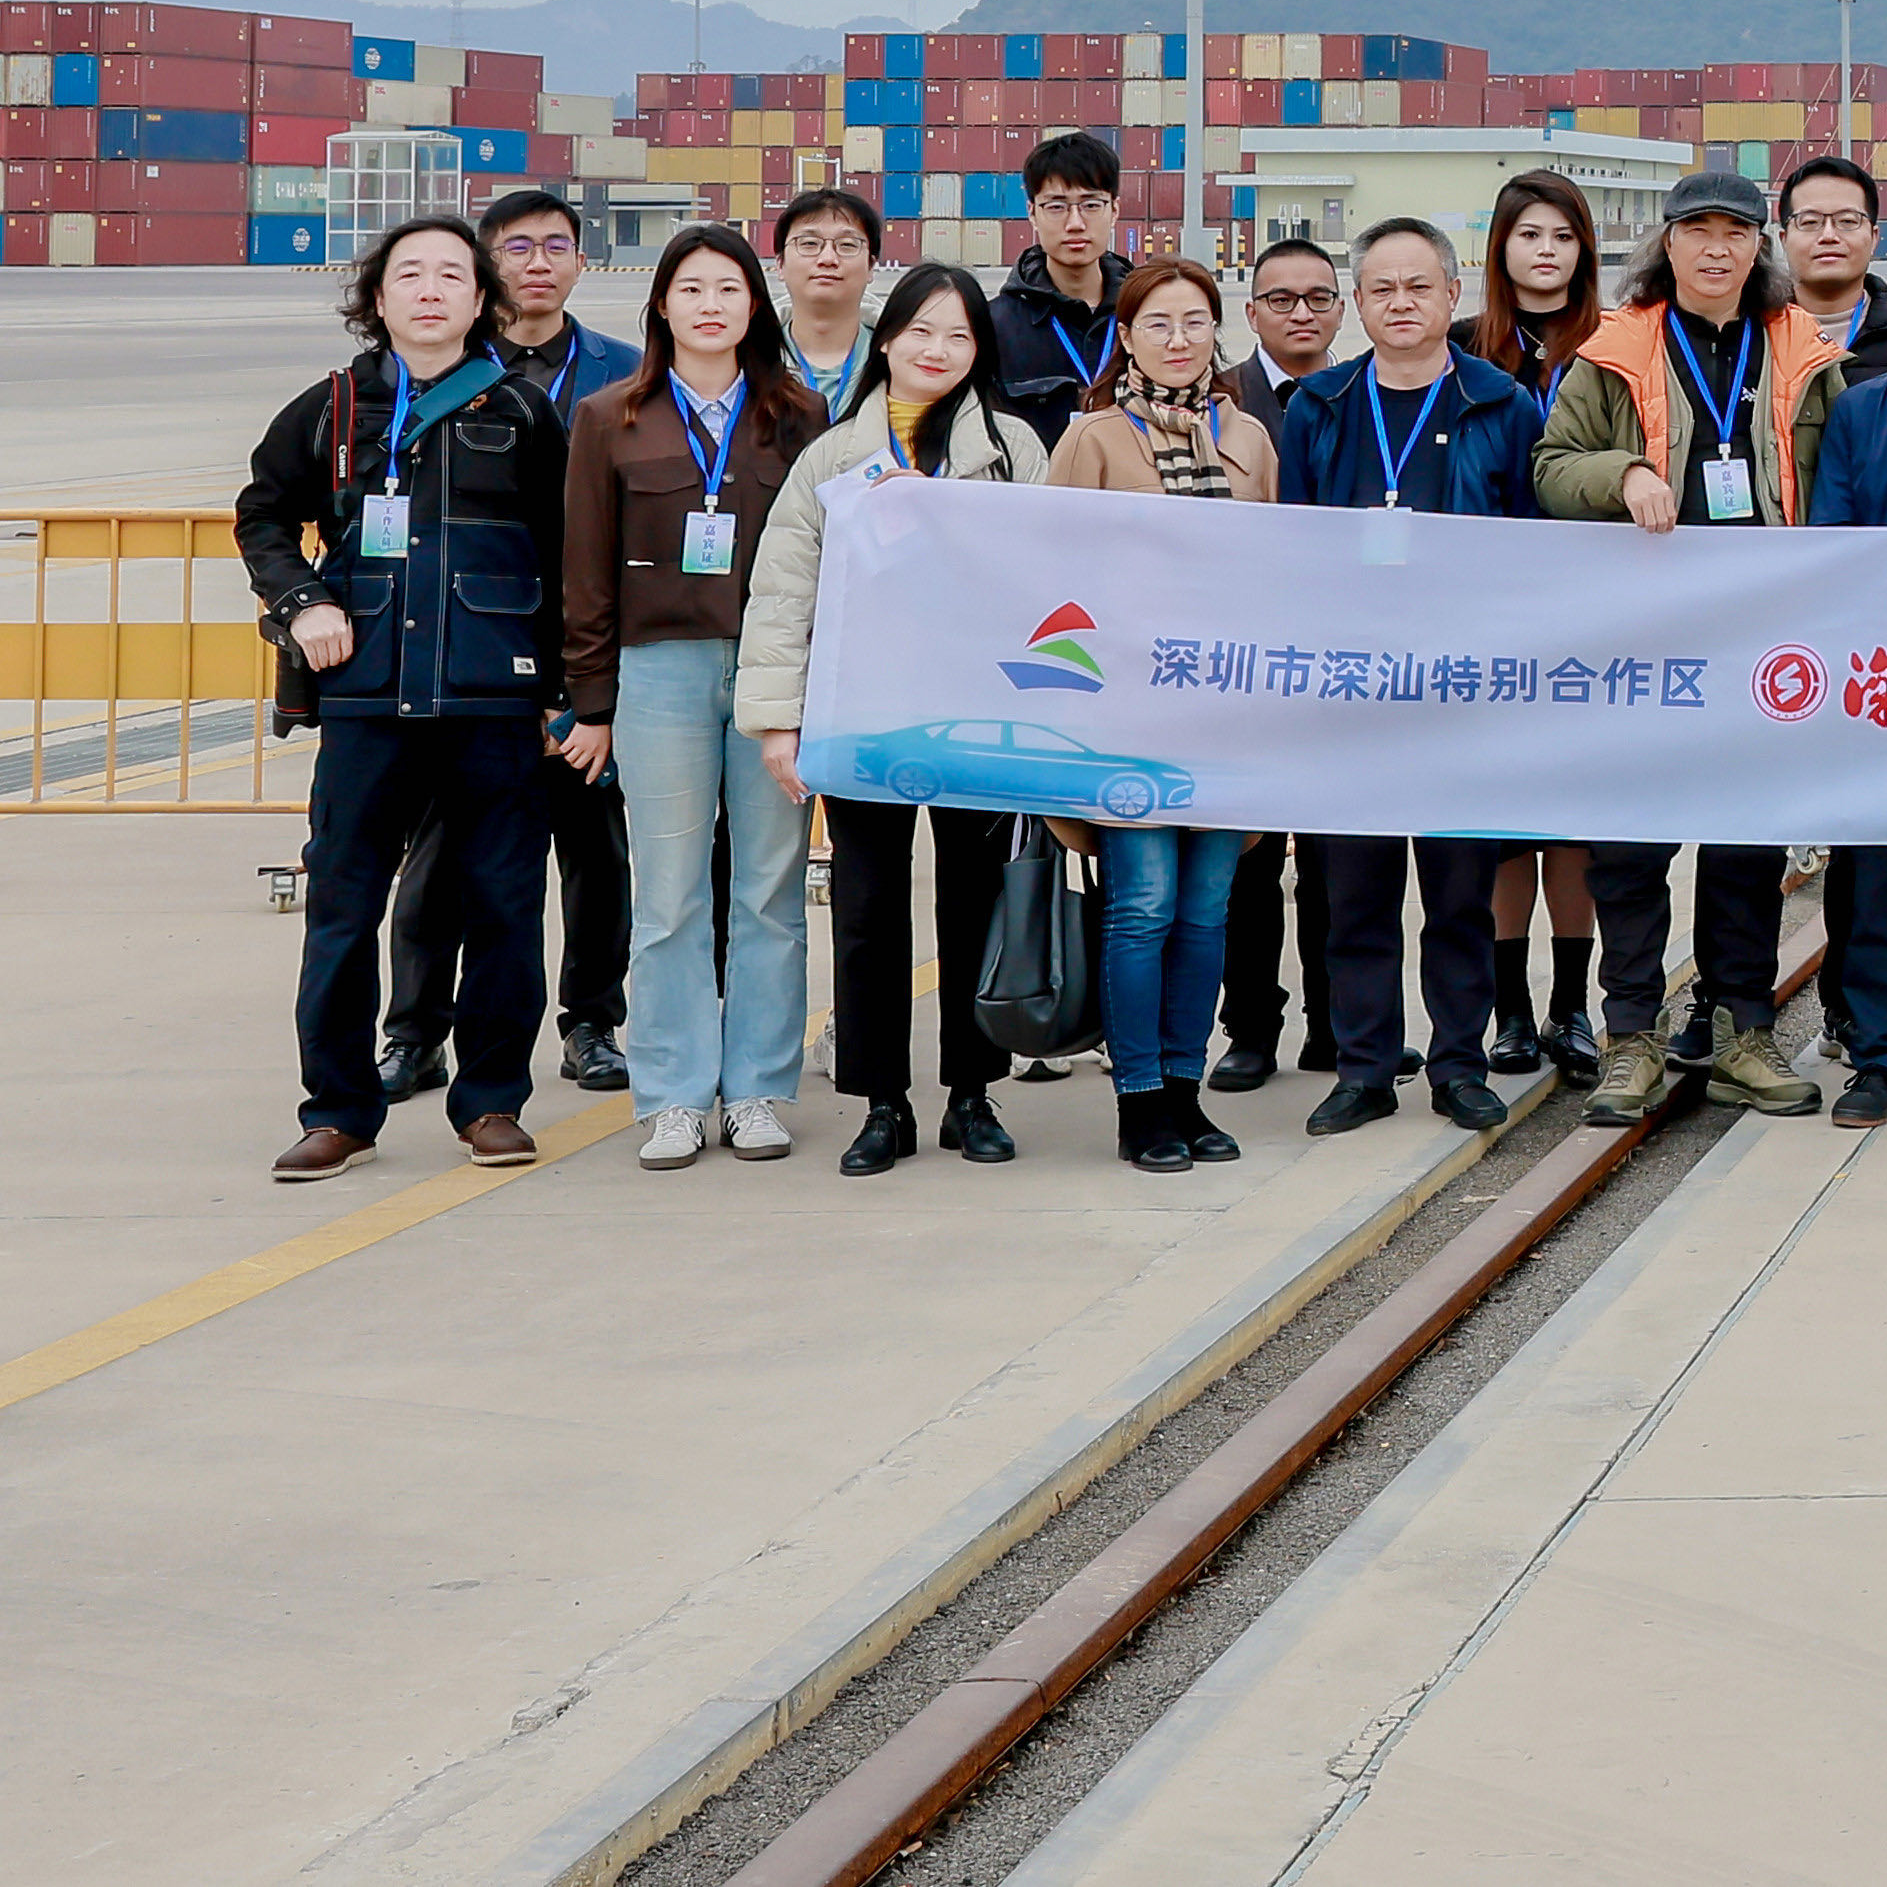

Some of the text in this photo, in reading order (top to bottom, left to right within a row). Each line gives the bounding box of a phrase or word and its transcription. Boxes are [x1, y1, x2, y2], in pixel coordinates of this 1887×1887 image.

[338, 444, 347, 478] Canon
[1150, 637, 1709, 709] 深圳市深汕特别合作区
